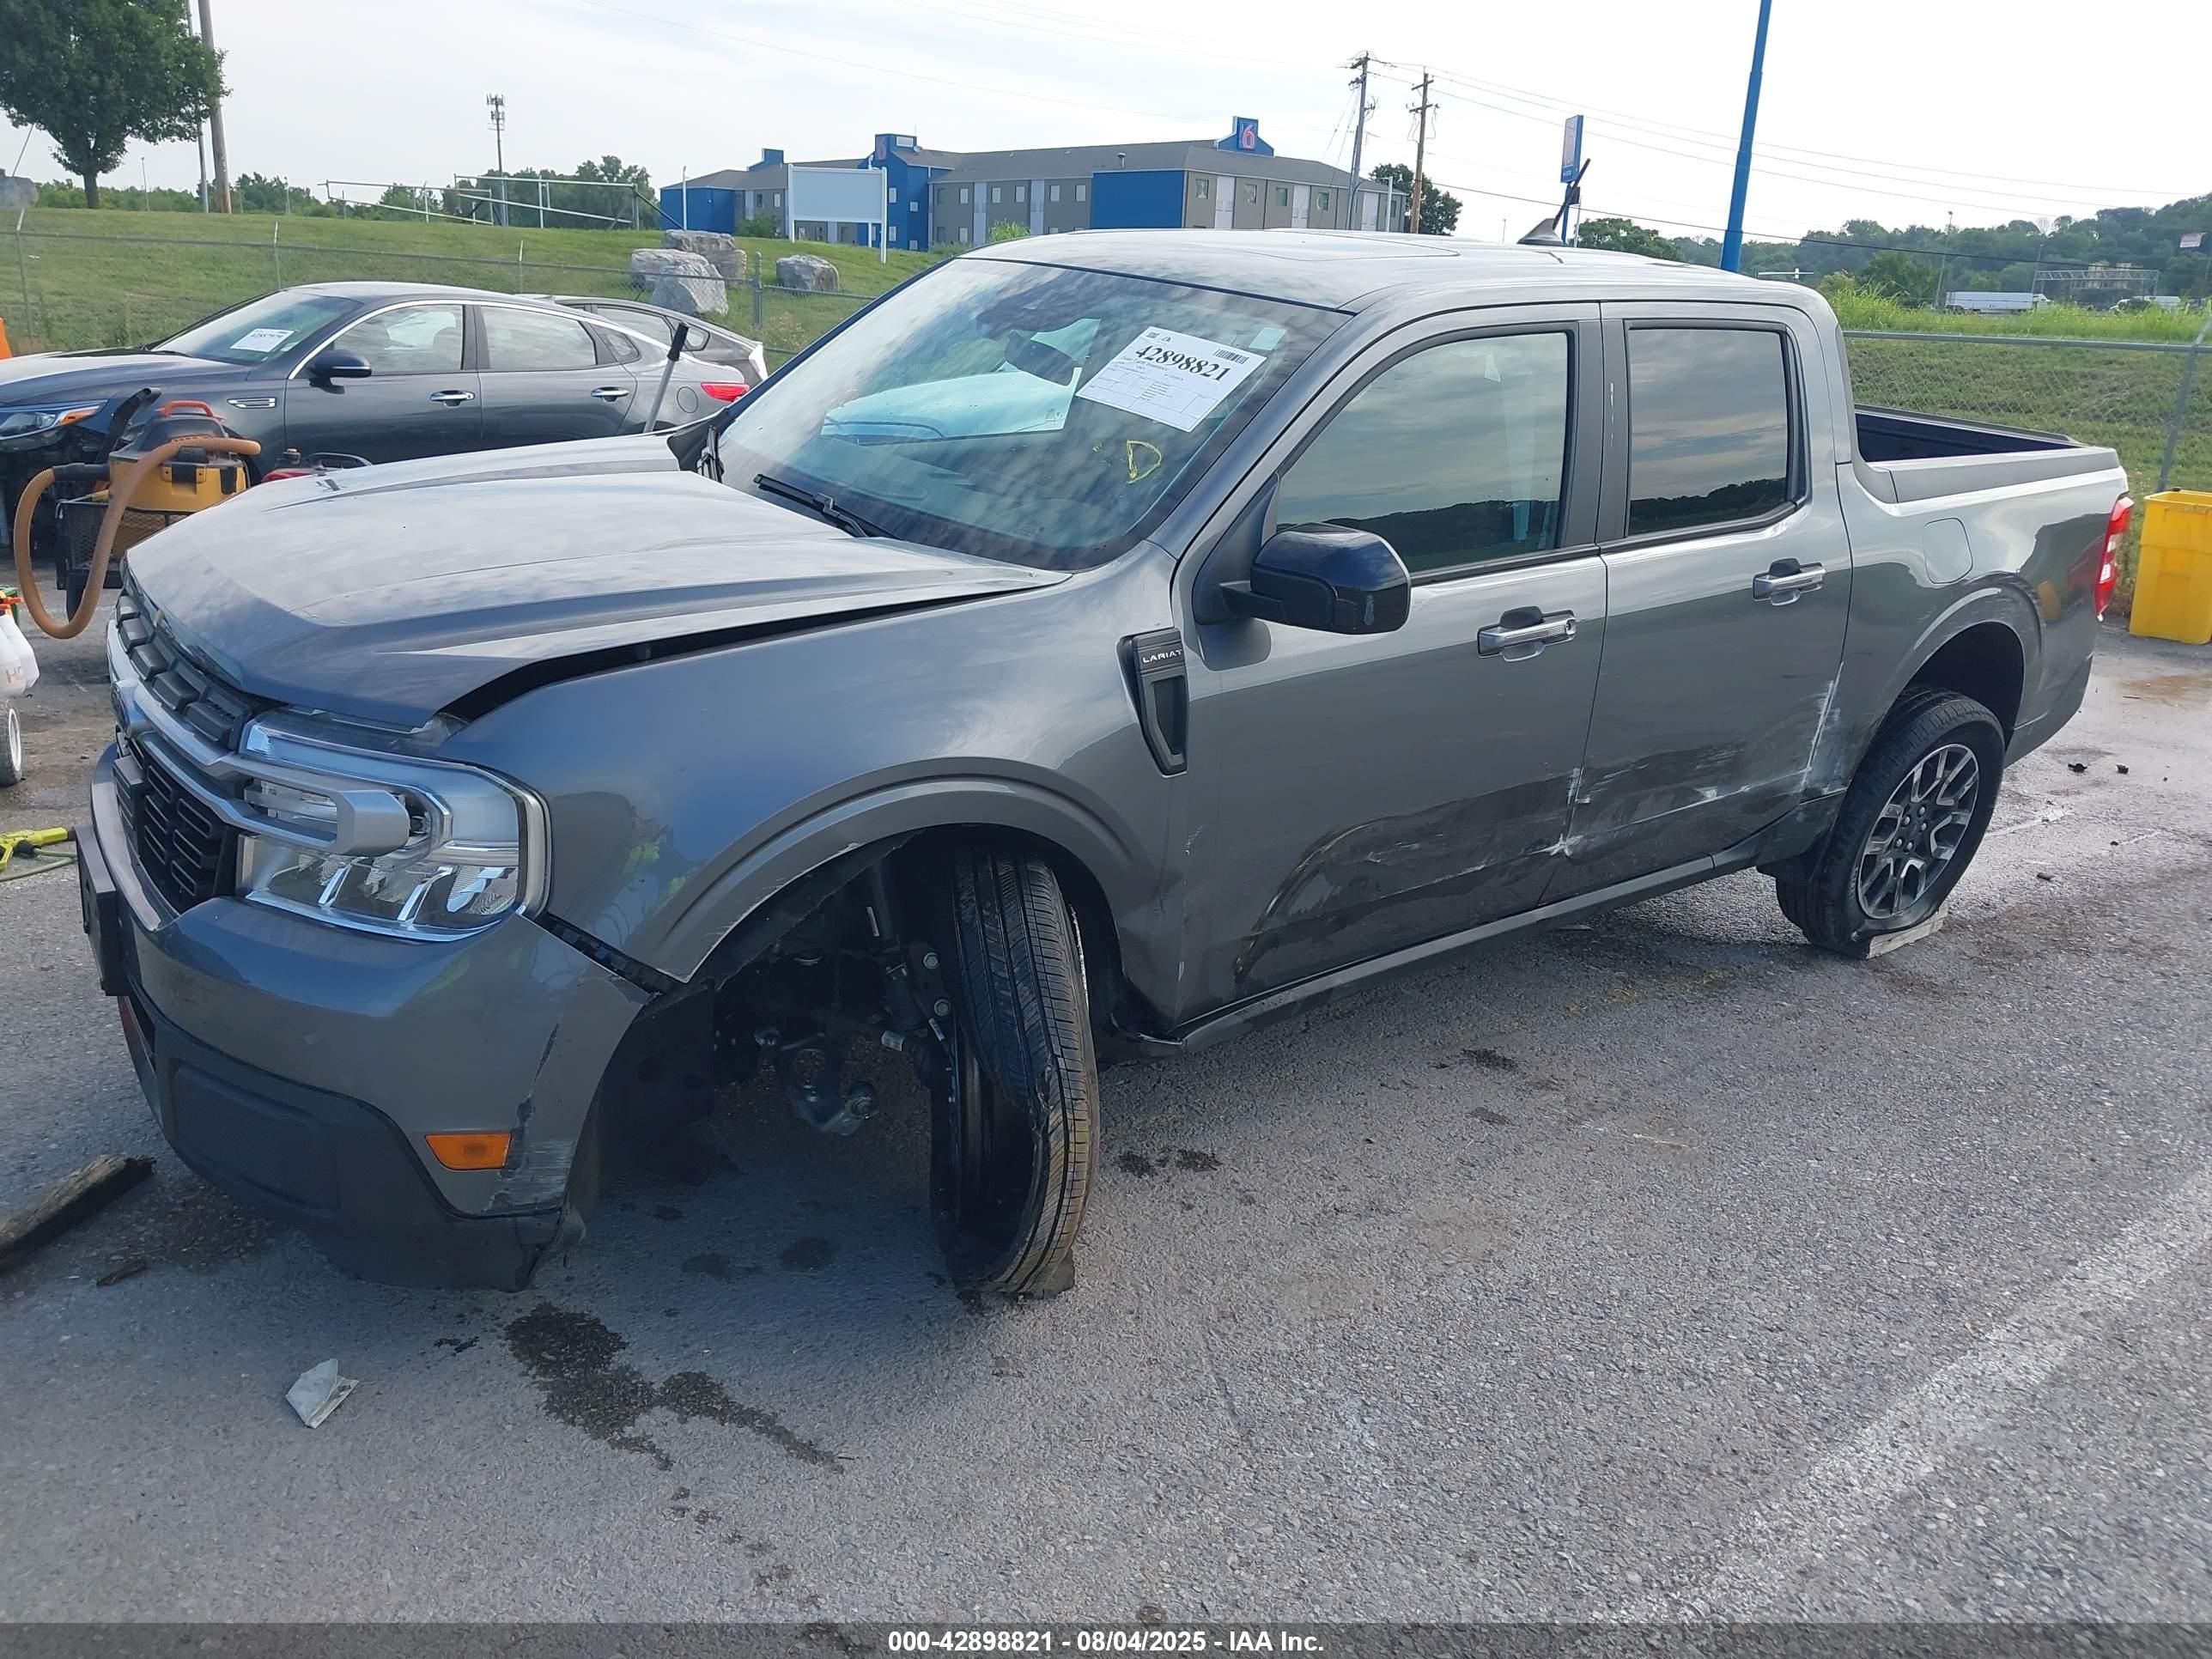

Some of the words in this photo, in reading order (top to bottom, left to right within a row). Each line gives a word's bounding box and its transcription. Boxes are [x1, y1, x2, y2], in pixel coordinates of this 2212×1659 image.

[1242, 124, 1255, 149] 6
[1135, 345, 1231, 380] 42898821
[1142, 648, 1182, 663] LARIAT
